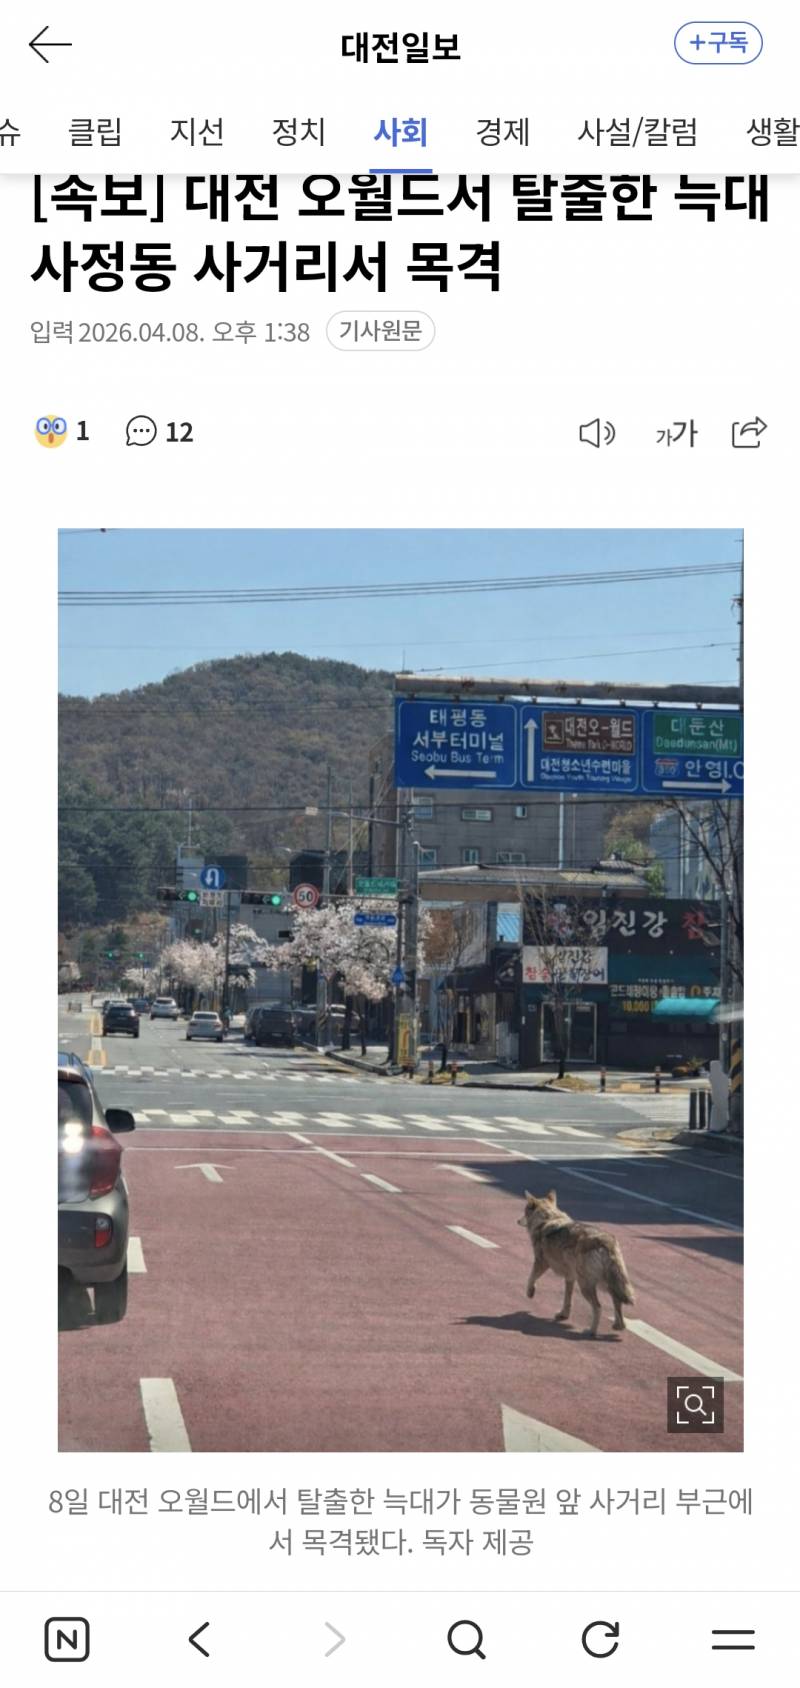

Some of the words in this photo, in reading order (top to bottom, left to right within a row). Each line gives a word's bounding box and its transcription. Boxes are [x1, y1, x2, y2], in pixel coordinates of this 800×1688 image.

[341, 31, 462, 64] 대전일보
[689, 31, 749, 54] +구독
[0, 118, 21, 147] 슈
[68, 117, 121, 147] 클립
[170, 117, 224, 147] 지선
[272, 117, 325, 147] 정치
[373, 117, 427, 148] 사회
[476, 116, 529, 147] 경제
[577, 116, 697, 149] 사설/칼럼
[746, 116, 800, 147] 생활
[34, 174, 164, 223] [속보]
[185, 174, 279, 223] 대전
[297, 174, 491, 223] 오월드서
[512, 174, 658, 222] 탈출한
[673, 174, 769, 223] 늑대
[30, 240, 177, 293] 사정동
[192, 240, 387, 293] 사거리서
[406, 240, 500, 293] 목격
[30, 320, 73, 345] 입력
[78, 322, 205, 344] 2026.04.08.
[212, 320, 257, 345] 오후
[264, 322, 310, 344] 1:38
[339, 319, 423, 343] 기사원문
[76, 420, 90, 441] 1
[165, 421, 194, 443] 12
[429, 708, 487, 728] 태평동
[670, 717, 725, 737] 대둔산
[412, 729, 504, 752] 서부터미널
[410, 750, 447, 763] Seobu
[450, 751, 471, 764] Bus
[298, 890, 313, 902] 50
[583, 908, 669, 938] 임진강
[48, 1487, 89, 1516] 8일
[98, 1487, 148, 1516] 대전
[157, 1487, 287, 1516] 오월드에서
[297, 1487, 376, 1516] 탈출한
[383, 1487, 462, 1516] 늑대가
[469, 1487, 546, 1516] 동물원
[556, 1487, 582, 1516] 앞
[589, 1487, 665, 1516] 사거리
[675, 1487, 752, 1516] 부근에
[269, 1528, 292, 1557] 서
[302, 1528, 413, 1557] 목격됐다.
[422, 1528, 475, 1557] 독자
[482, 1528, 534, 1557] 제공
